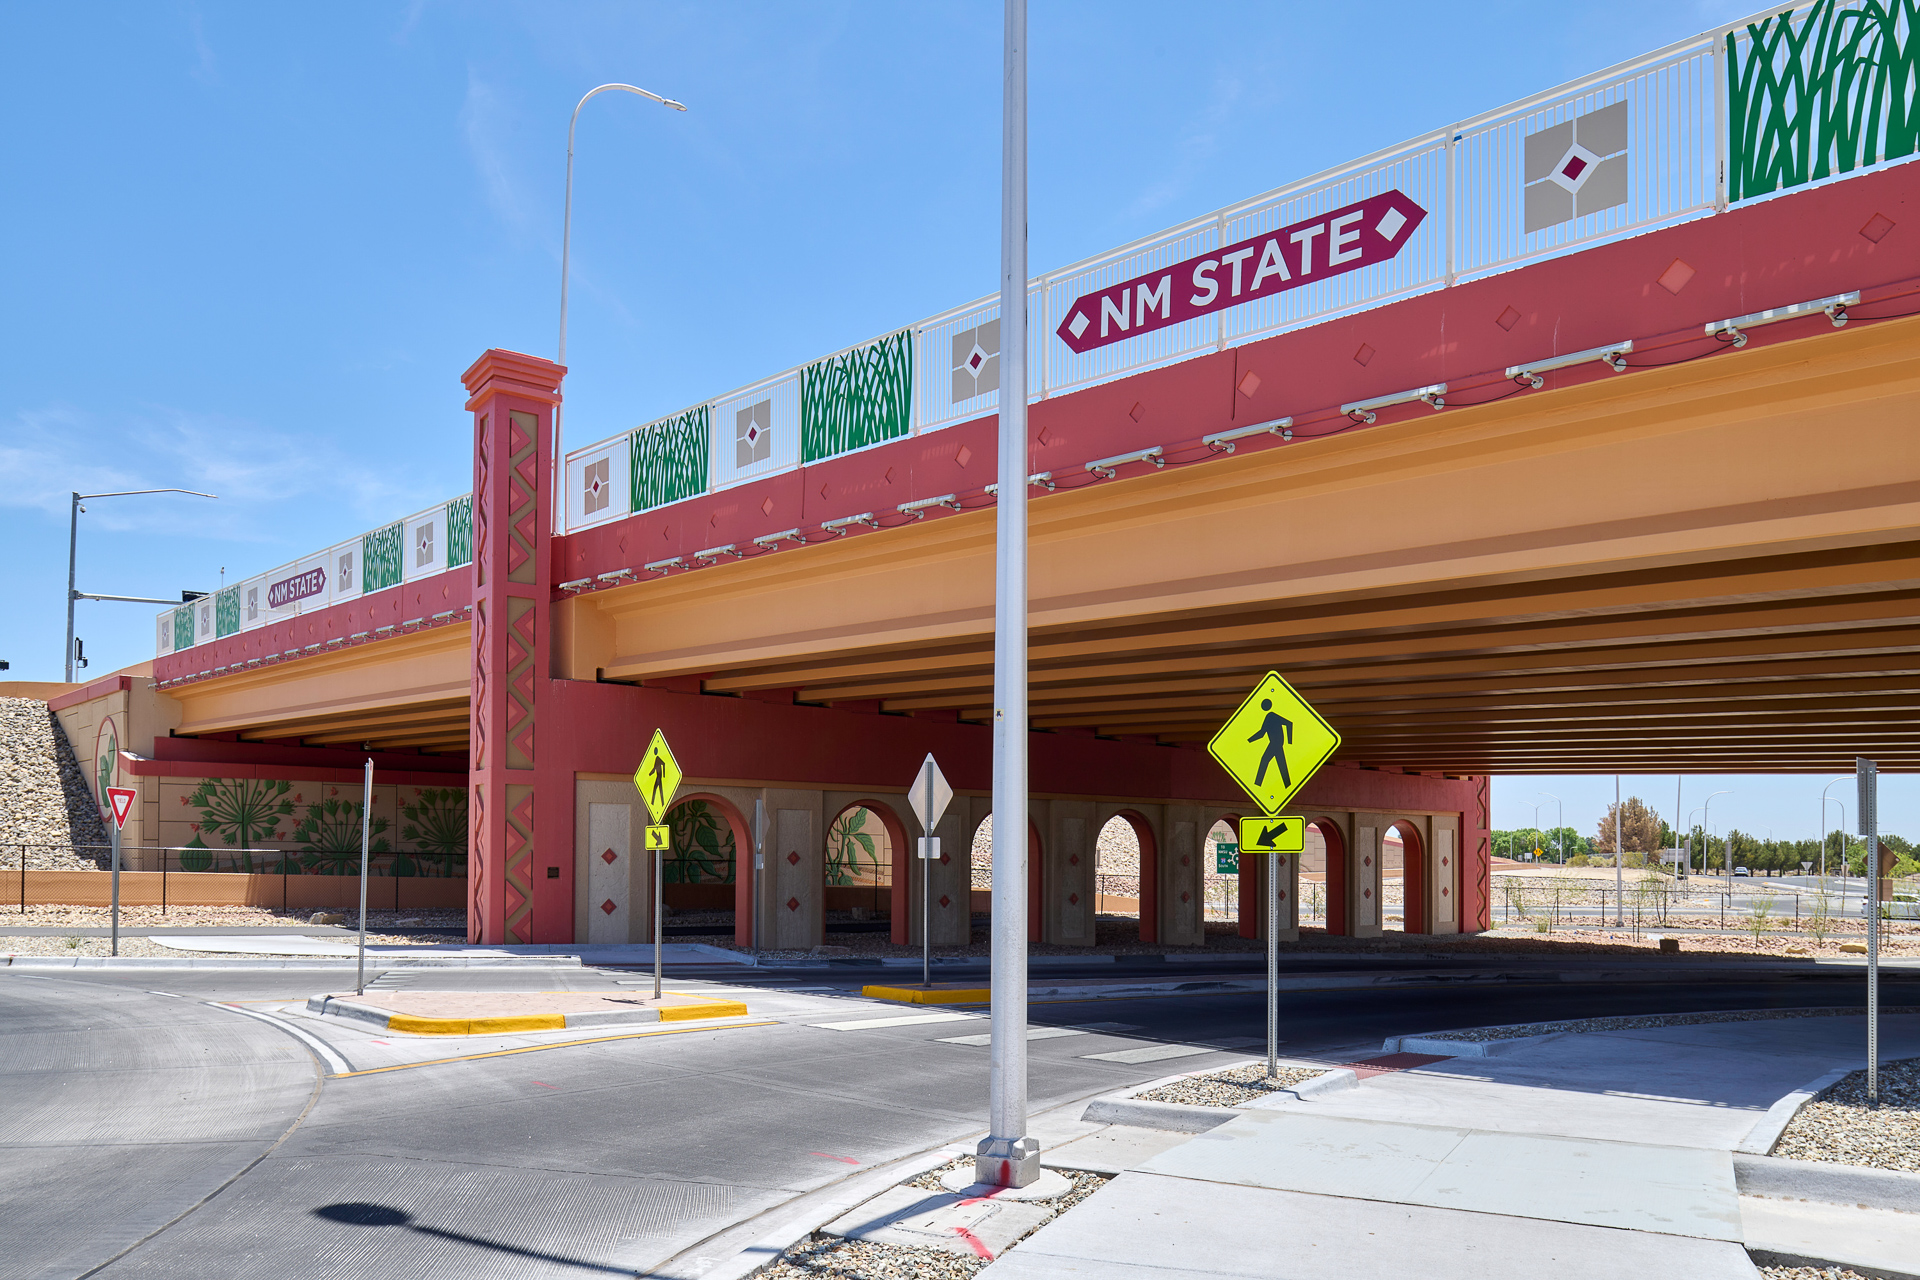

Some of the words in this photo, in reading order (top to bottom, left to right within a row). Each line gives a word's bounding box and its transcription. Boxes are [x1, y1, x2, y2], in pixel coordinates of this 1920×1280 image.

[1100, 275, 1171, 338] NM
[1189, 209, 1364, 306] STATE
[274, 582, 288, 604] NM
[289, 571, 318, 599] STATE
